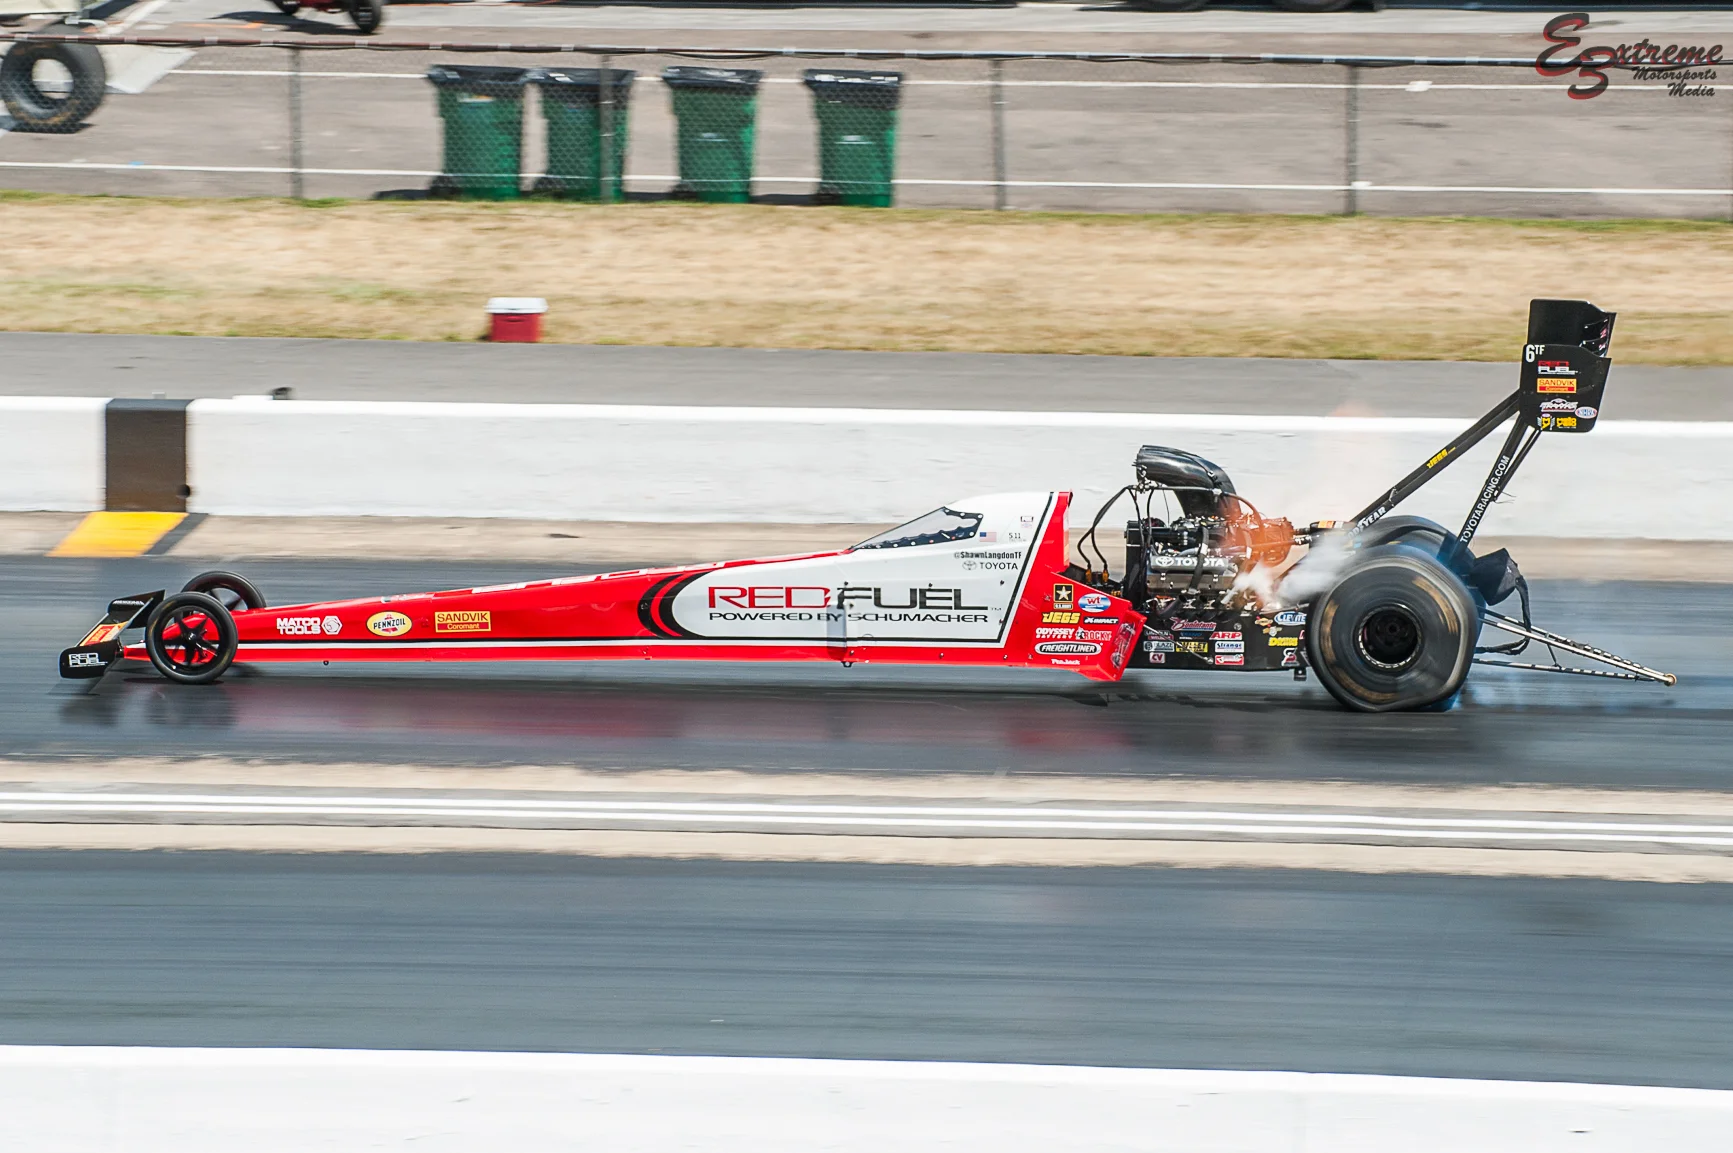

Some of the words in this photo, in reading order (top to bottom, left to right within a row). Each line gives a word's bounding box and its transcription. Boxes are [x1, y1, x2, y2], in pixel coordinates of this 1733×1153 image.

[1459, 455, 1510, 543] TOYOTARACING.COM
[979, 562, 1018, 570] TOYOTA
[708, 586, 831, 609] RED
[837, 587, 989, 611] FUEL
[276, 617, 321, 627] MATCO
[437, 613, 488, 623] SANDVIK
[709, 612, 813, 622] POWERED
[817, 613, 842, 623] BY
[847, 612, 989, 623] SCHUMACHER
[1042, 612, 1081, 624] JEGS
[373, 618, 406, 630] PENNZOIL
[277, 626, 321, 635] TOOLS
[1036, 627, 1075, 635] ODYSSEY
[1084, 631, 1112, 641] ROCKY
[1041, 644, 1095, 653] FREIGHTLINER
